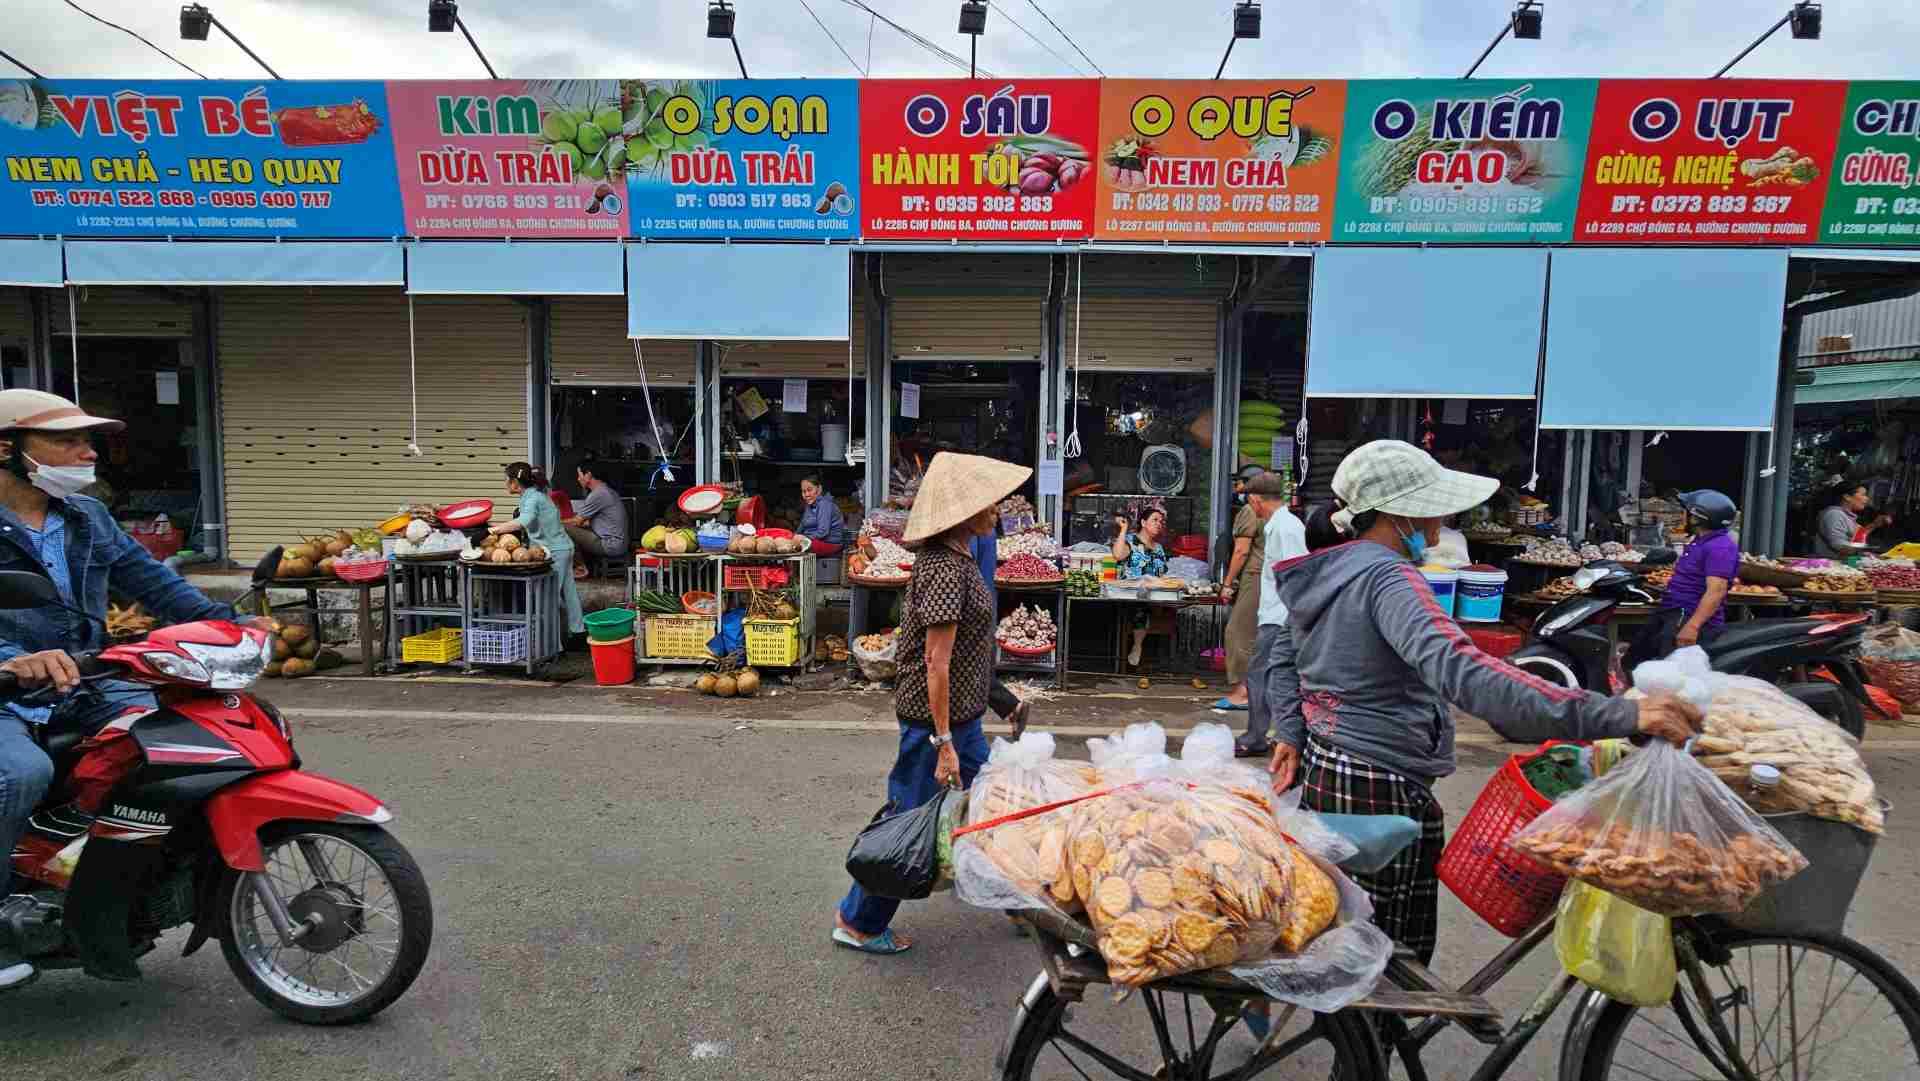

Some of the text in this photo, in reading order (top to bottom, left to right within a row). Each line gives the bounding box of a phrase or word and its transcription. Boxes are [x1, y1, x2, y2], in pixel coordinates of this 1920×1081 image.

[49, 87, 274, 142] VIỆT BÉ
[662, 95, 829, 141] O SOẠN
[904, 84, 1052, 138] O SÁU
[1130, 86, 1316, 140] O QUẾ
[1372, 83, 1563, 141] O KIẾM
[1629, 97, 1794, 149] O LỤT
[1853, 99, 1920, 140] CH
[6, 157, 83, 182] NEM
[91, 150, 159, 183] CHẢ
[187, 158, 254, 183] HEO
[263, 159, 342, 186] QUAY
[418, 144, 574, 186] DỪA TRÁI
[671, 143, 815, 186] DỪA TRÁI
[872, 144, 1019, 185] HÀNH TỎI
[1147, 151, 1288, 188] NEM CHẢ
[1416, 150, 1508, 192] GẠO
[1596, 150, 1739, 191] GỪNG, NGHỆ
[1841, 147, 1913, 189] GỪNG,
[69, 189, 114, 207] 0774
[118, 190, 154, 207] 522
[159, 190, 195, 207] 868
[210, 190, 257, 208] 0905
[261, 190, 297, 208] 400
[300, 190, 332, 208] 717
[462, 194, 508, 209] 0766
[513, 194, 548, 209] 503
[554, 194, 582, 209] 211
[708, 193, 746, 208] 0903
[751, 193, 776, 208] 517
[781, 193, 811, 208] 963
[935, 196, 978, 212] 0935
[982, 196, 1015, 212] 302
[1020, 196, 1053, 212] 363
[1136, 192, 1169, 211] 0342
[1172, 193, 1194, 212] 413
[1231, 193, 1264, 212] 0775
[1267, 193, 1291, 212] 452
[1295, 193, 1320, 212] 522
[1409, 197, 1457, 214] 0905
[1505, 197, 1543, 214] 652
[1651, 196, 1702, 213] 0373
[1707, 196, 1747, 213] 883
[1752, 196, 1792, 213] 367
[112, 804, 167, 824] YAMAHA
